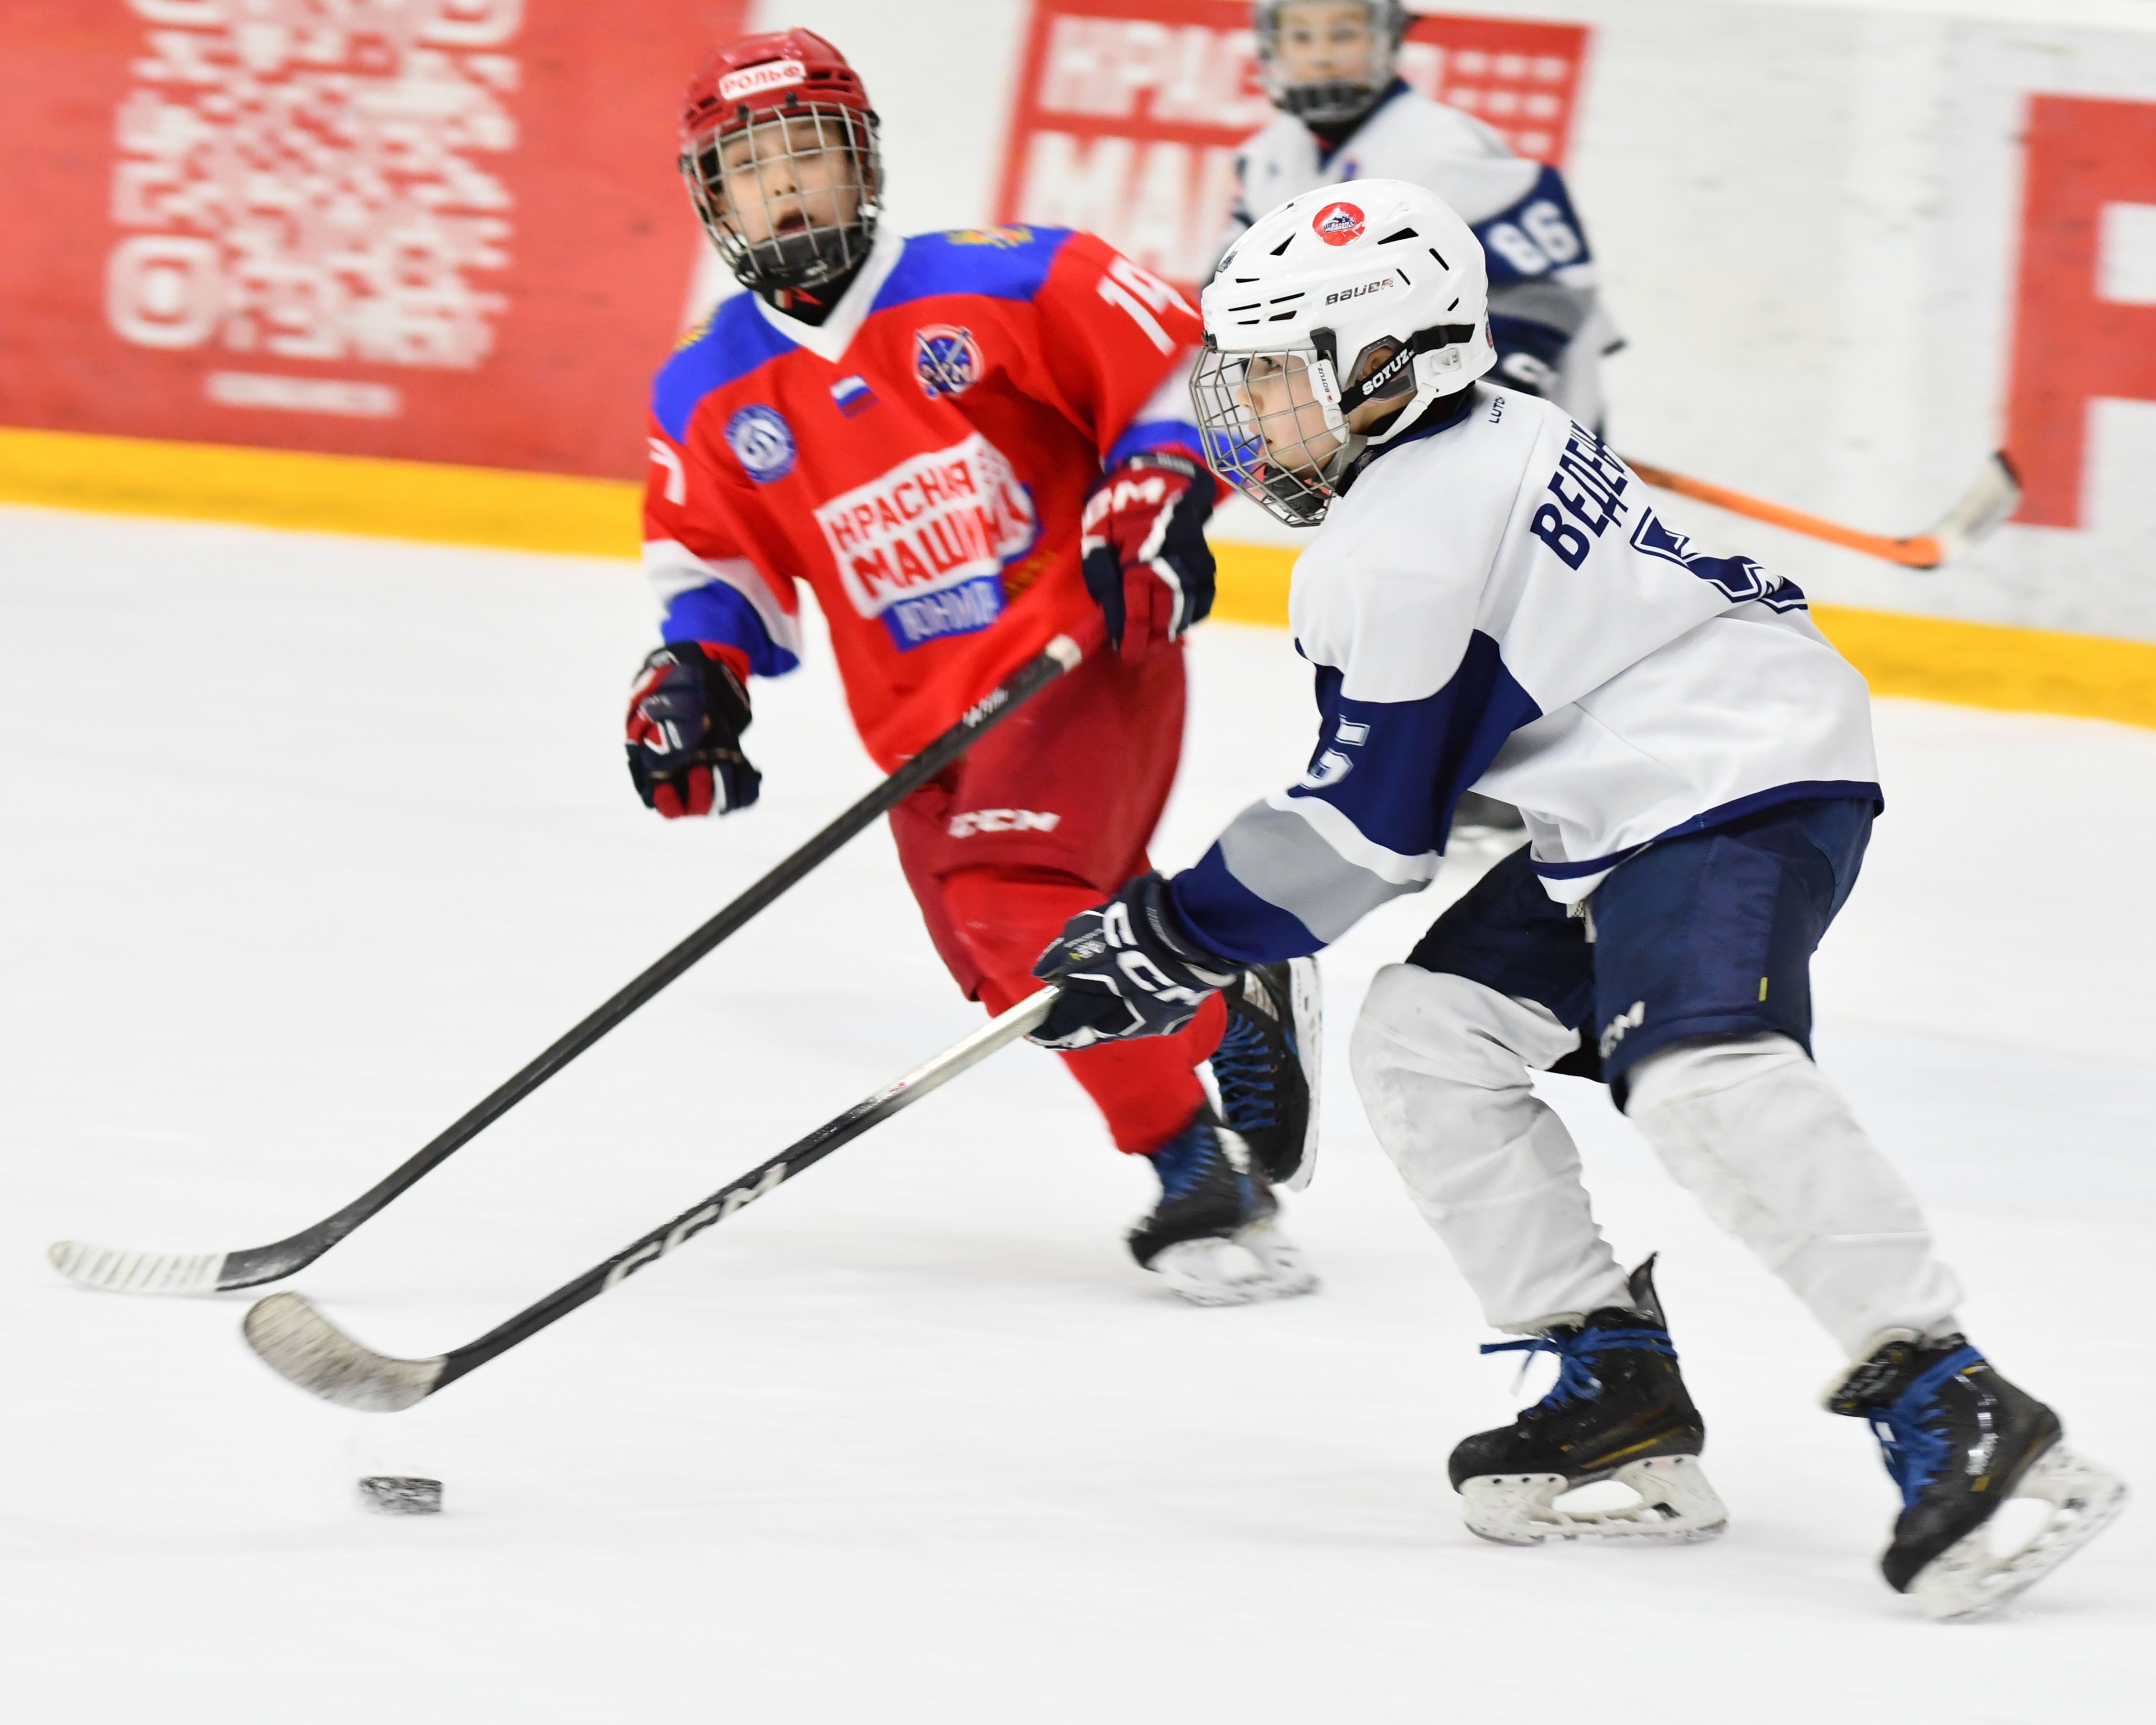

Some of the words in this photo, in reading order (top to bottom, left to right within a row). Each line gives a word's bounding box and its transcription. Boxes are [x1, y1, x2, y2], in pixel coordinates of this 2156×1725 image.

[724, 65, 800, 94] РОЛЬФ
[1486, 199, 1581, 275] 86
[1325, 277, 1394, 306] BAUER
[1317, 367, 1331, 393] SOYUZ
[1362, 348, 1409, 396] SOYUZ
